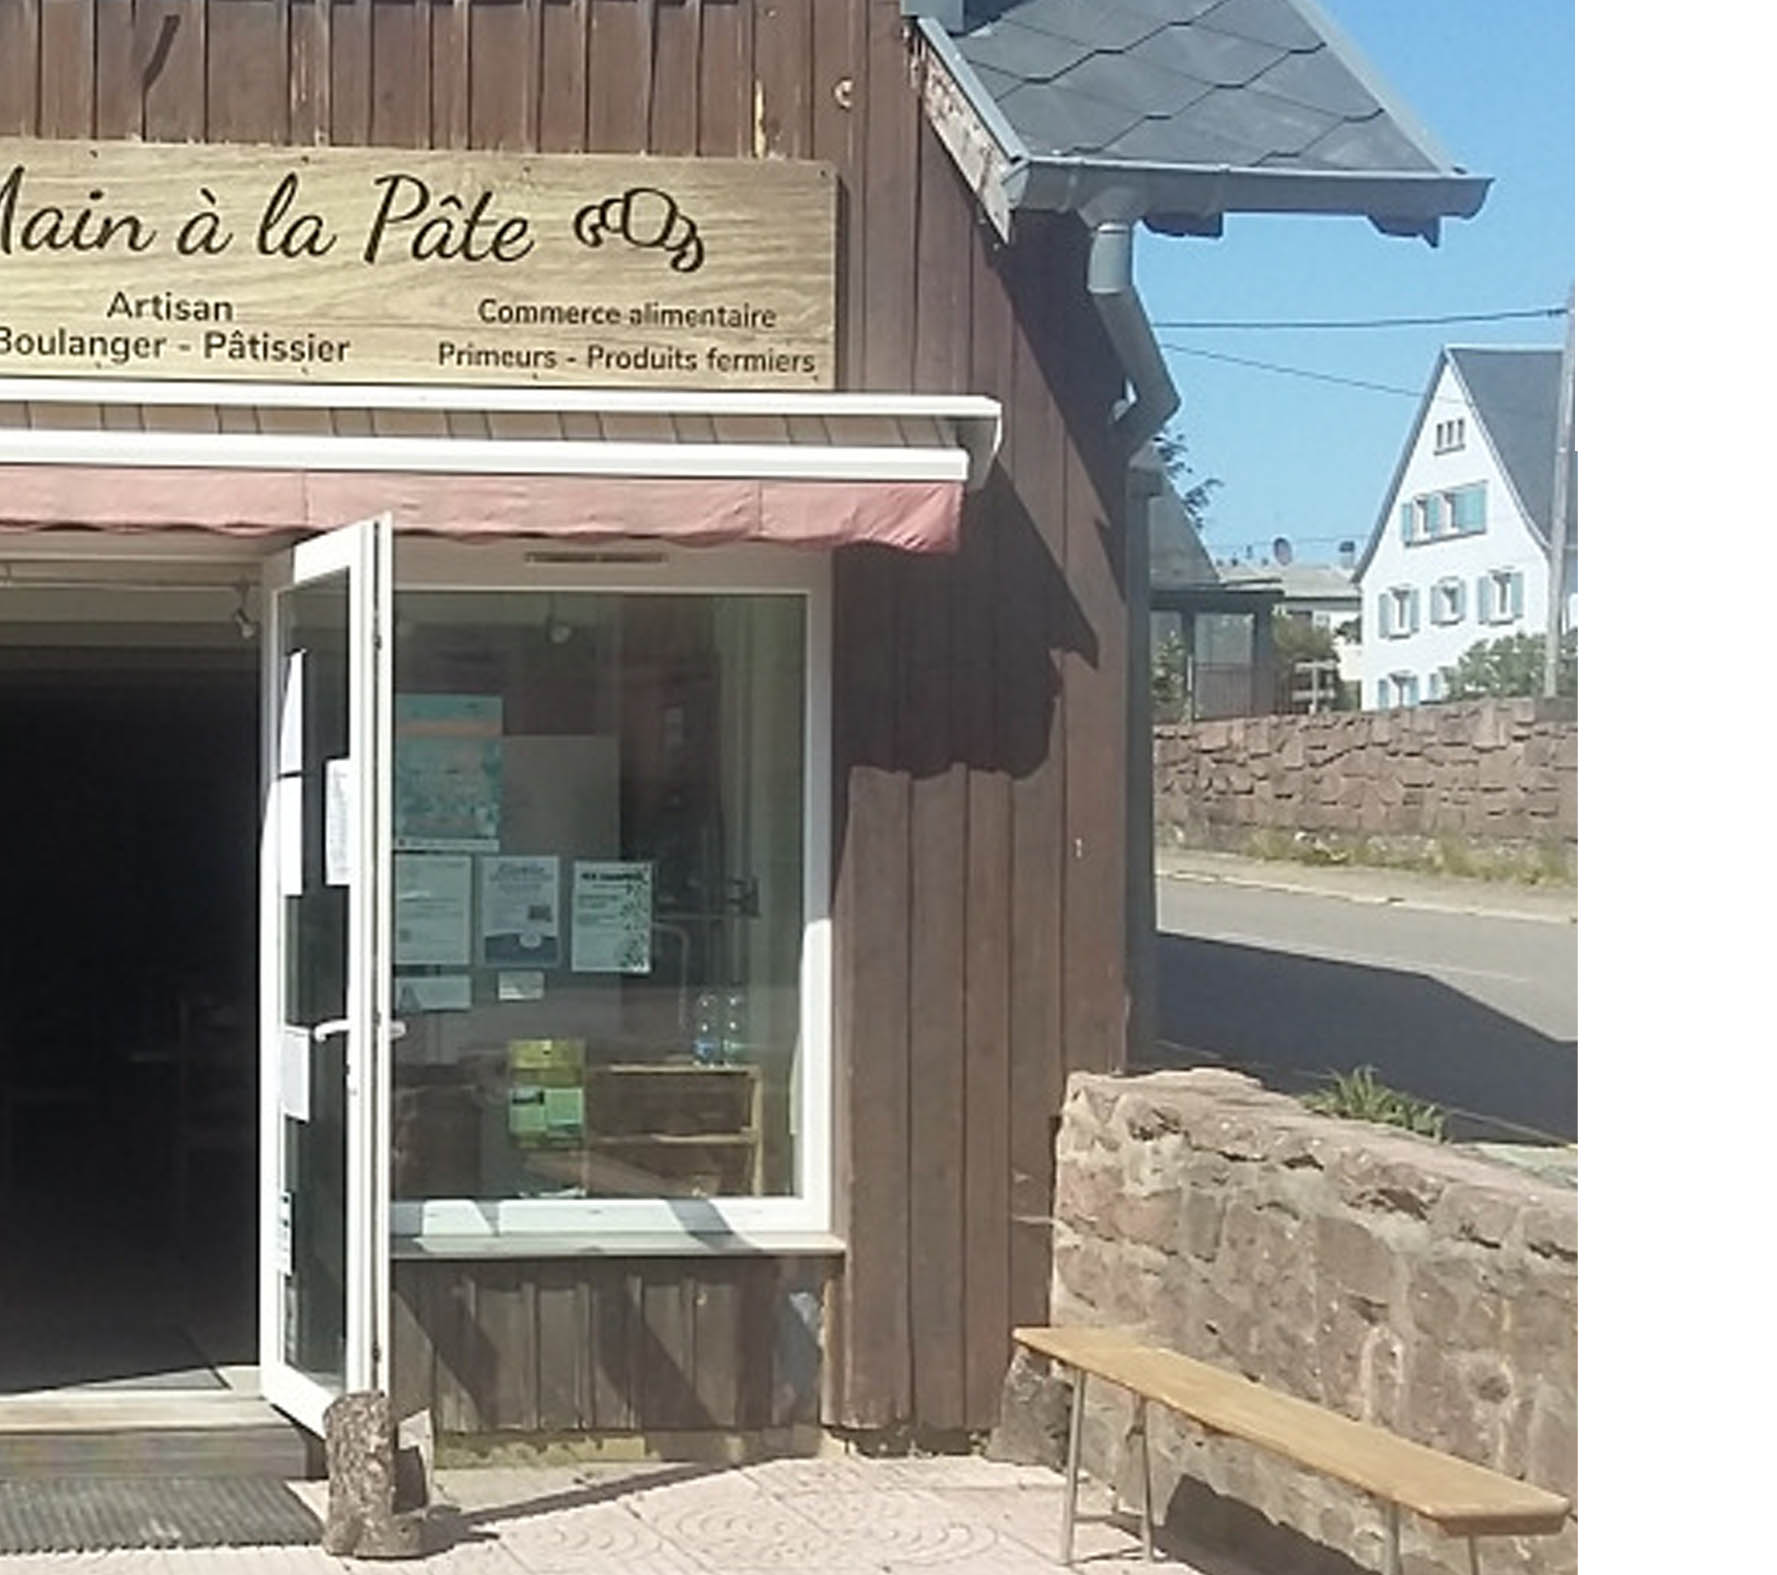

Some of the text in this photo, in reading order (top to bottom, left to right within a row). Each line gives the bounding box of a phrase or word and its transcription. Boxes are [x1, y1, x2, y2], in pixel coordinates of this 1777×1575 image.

[176, 187, 233, 256] à
[255, 172, 337, 258] la
[362, 172, 535, 264] Pâte
[106, 290, 234, 322] Artisan
[477, 298, 778, 328] Commerce alimentaire
[203, 329, 352, 363] Pâtissier
[437, 341, 558, 369] Primeurs
[586, 344, 698, 371] Produits
[706, 346, 817, 374] fermiers
